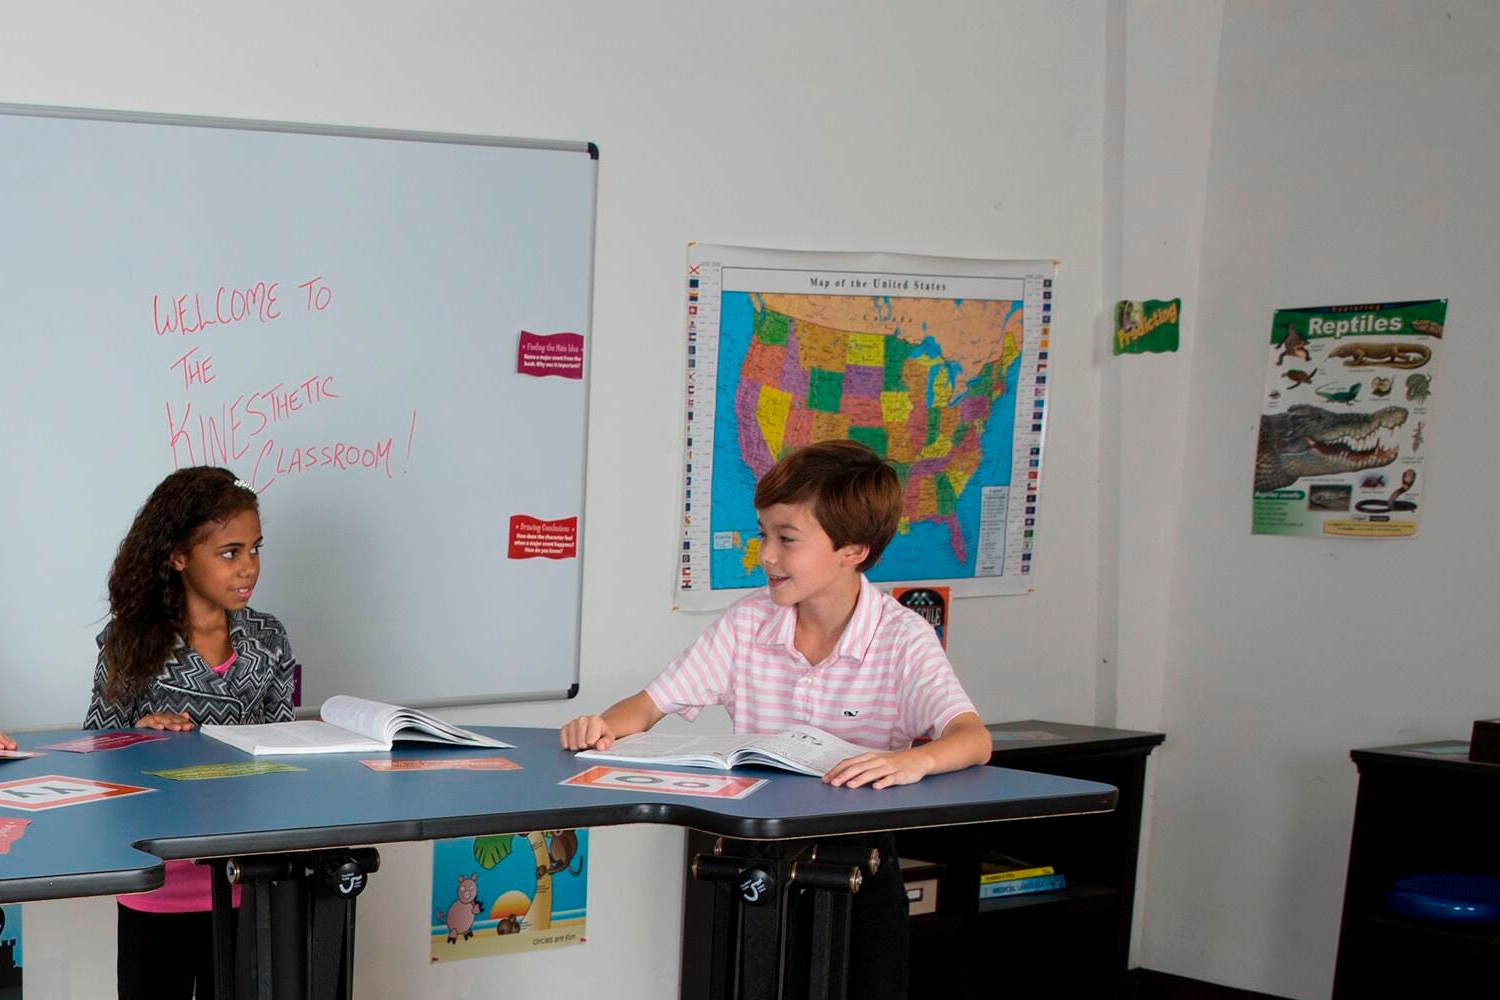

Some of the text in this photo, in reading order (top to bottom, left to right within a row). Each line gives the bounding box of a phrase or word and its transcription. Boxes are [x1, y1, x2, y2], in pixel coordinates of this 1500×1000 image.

[153, 276, 332, 335] WELCOME TO
[810, 278, 946, 291] Map of the United States
[1308, 315, 1404, 338] Reptiles
[170, 347, 216, 390] THE
[166, 376, 340, 470] KINESTHETIC
